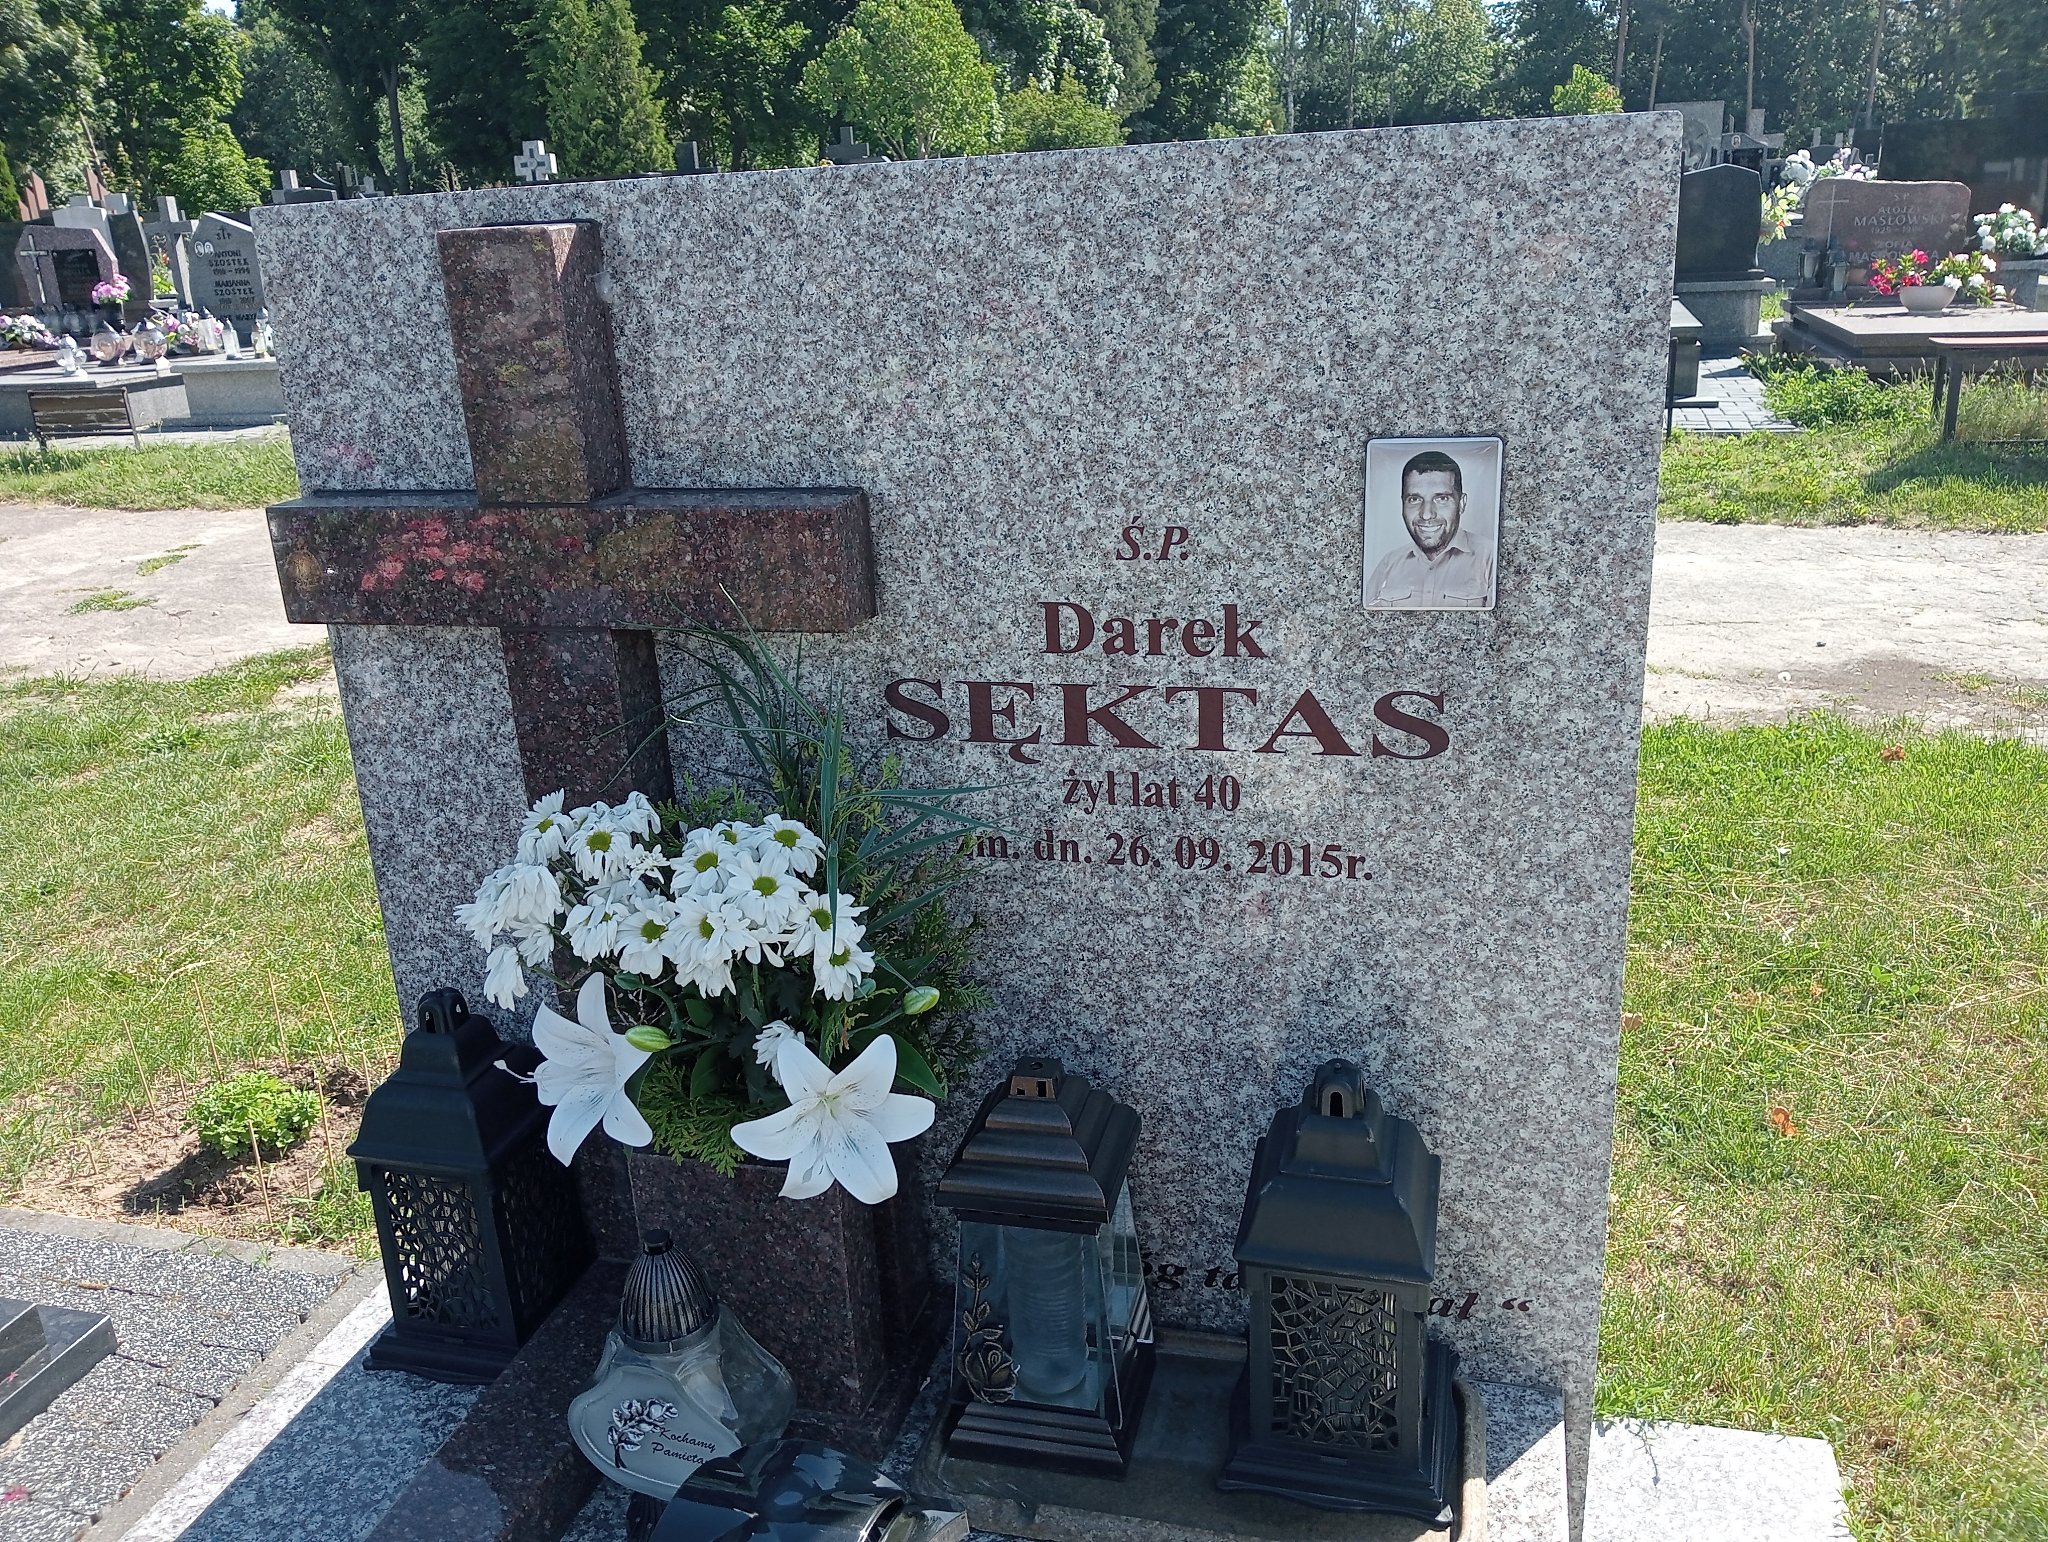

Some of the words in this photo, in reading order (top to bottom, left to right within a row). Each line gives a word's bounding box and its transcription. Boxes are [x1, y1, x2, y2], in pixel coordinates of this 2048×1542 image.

[1116, 515, 1189, 561] Ś.P.
[1041, 601, 1269, 659] Darek
[884, 677, 1451, 765] SĘKTAS
[1062, 769, 1118, 815] żył
[1130, 771, 1181, 809] lat
[1194, 774, 1241, 812] 40
[1034, 829, 1092, 864] dn.
[1106, 832, 1161, 868] 26.
[1175, 836, 1232, 872] 09.
[1246, 840, 1373, 881] 2015r.
[655, 1425, 716, 1453] Kochamy
